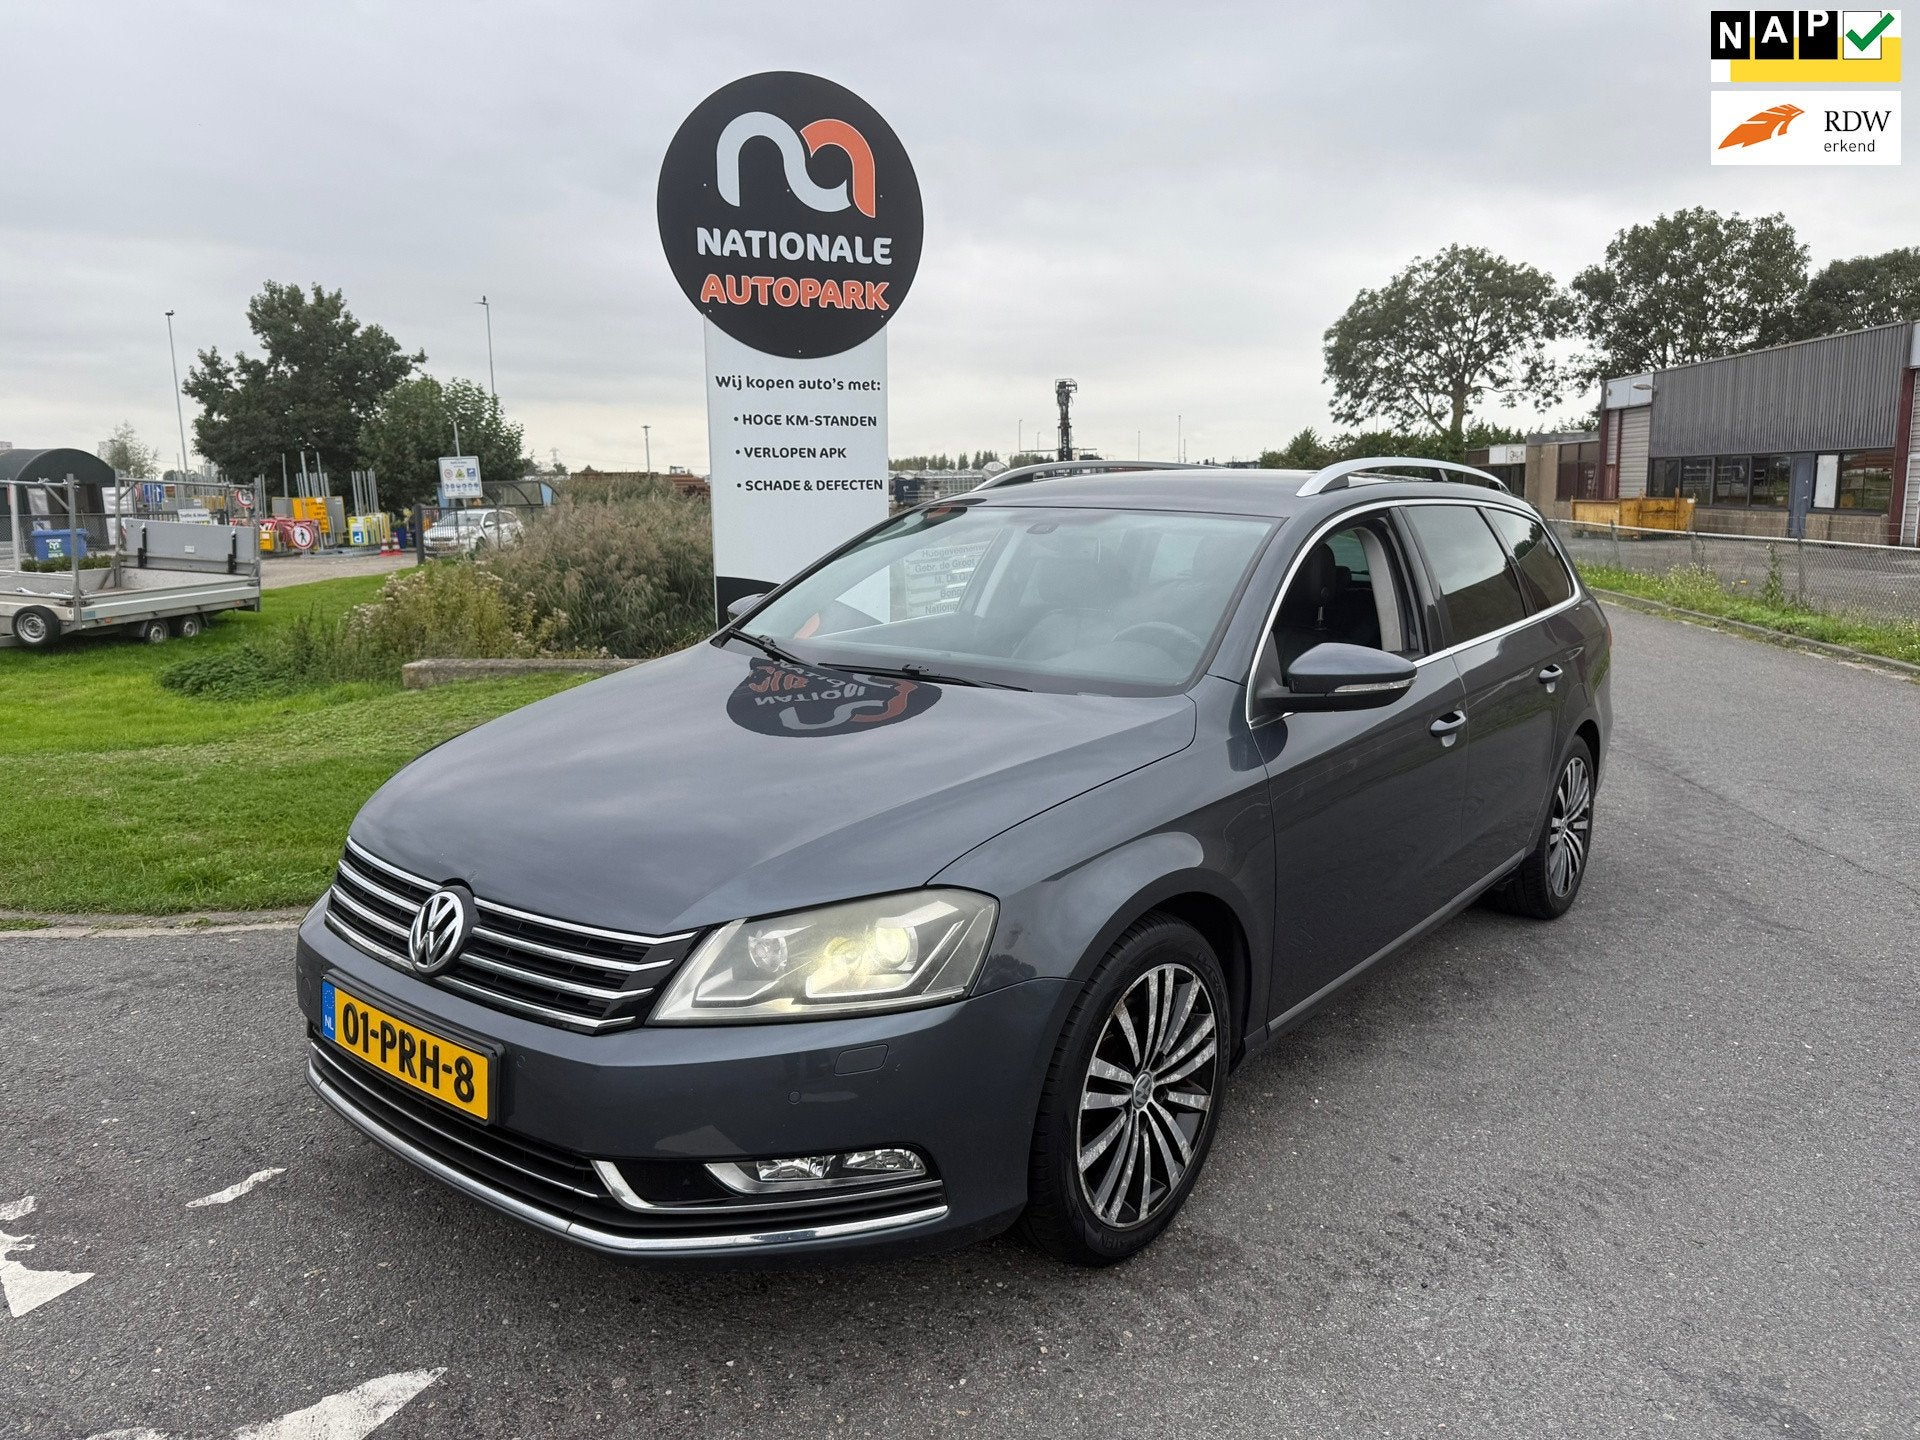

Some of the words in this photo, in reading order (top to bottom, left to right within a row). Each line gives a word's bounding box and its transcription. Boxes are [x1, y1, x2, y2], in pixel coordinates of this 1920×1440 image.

[697, 227, 892, 265] NATIONALE
[700, 273, 889, 311] AUTOPARK
[715, 375, 742, 391] Wij
[746, 376, 794, 391] kopen
[799, 378, 844, 390] auto's
[848, 379, 881, 391] met:
[743, 414, 782, 425] HOGE
[786, 415, 877, 427] KM-STANDEN
[744, 447, 816, 458] VERLOPEN
[820, 448, 847, 458] APK
[745, 480, 800, 491] SCHADE
[804, 481, 813, 491] &
[816, 480, 883, 490] DEFECTEN
[324, 1014, 334, 1030] NL
[342, 1003, 475, 1103] 01-PRH-8
